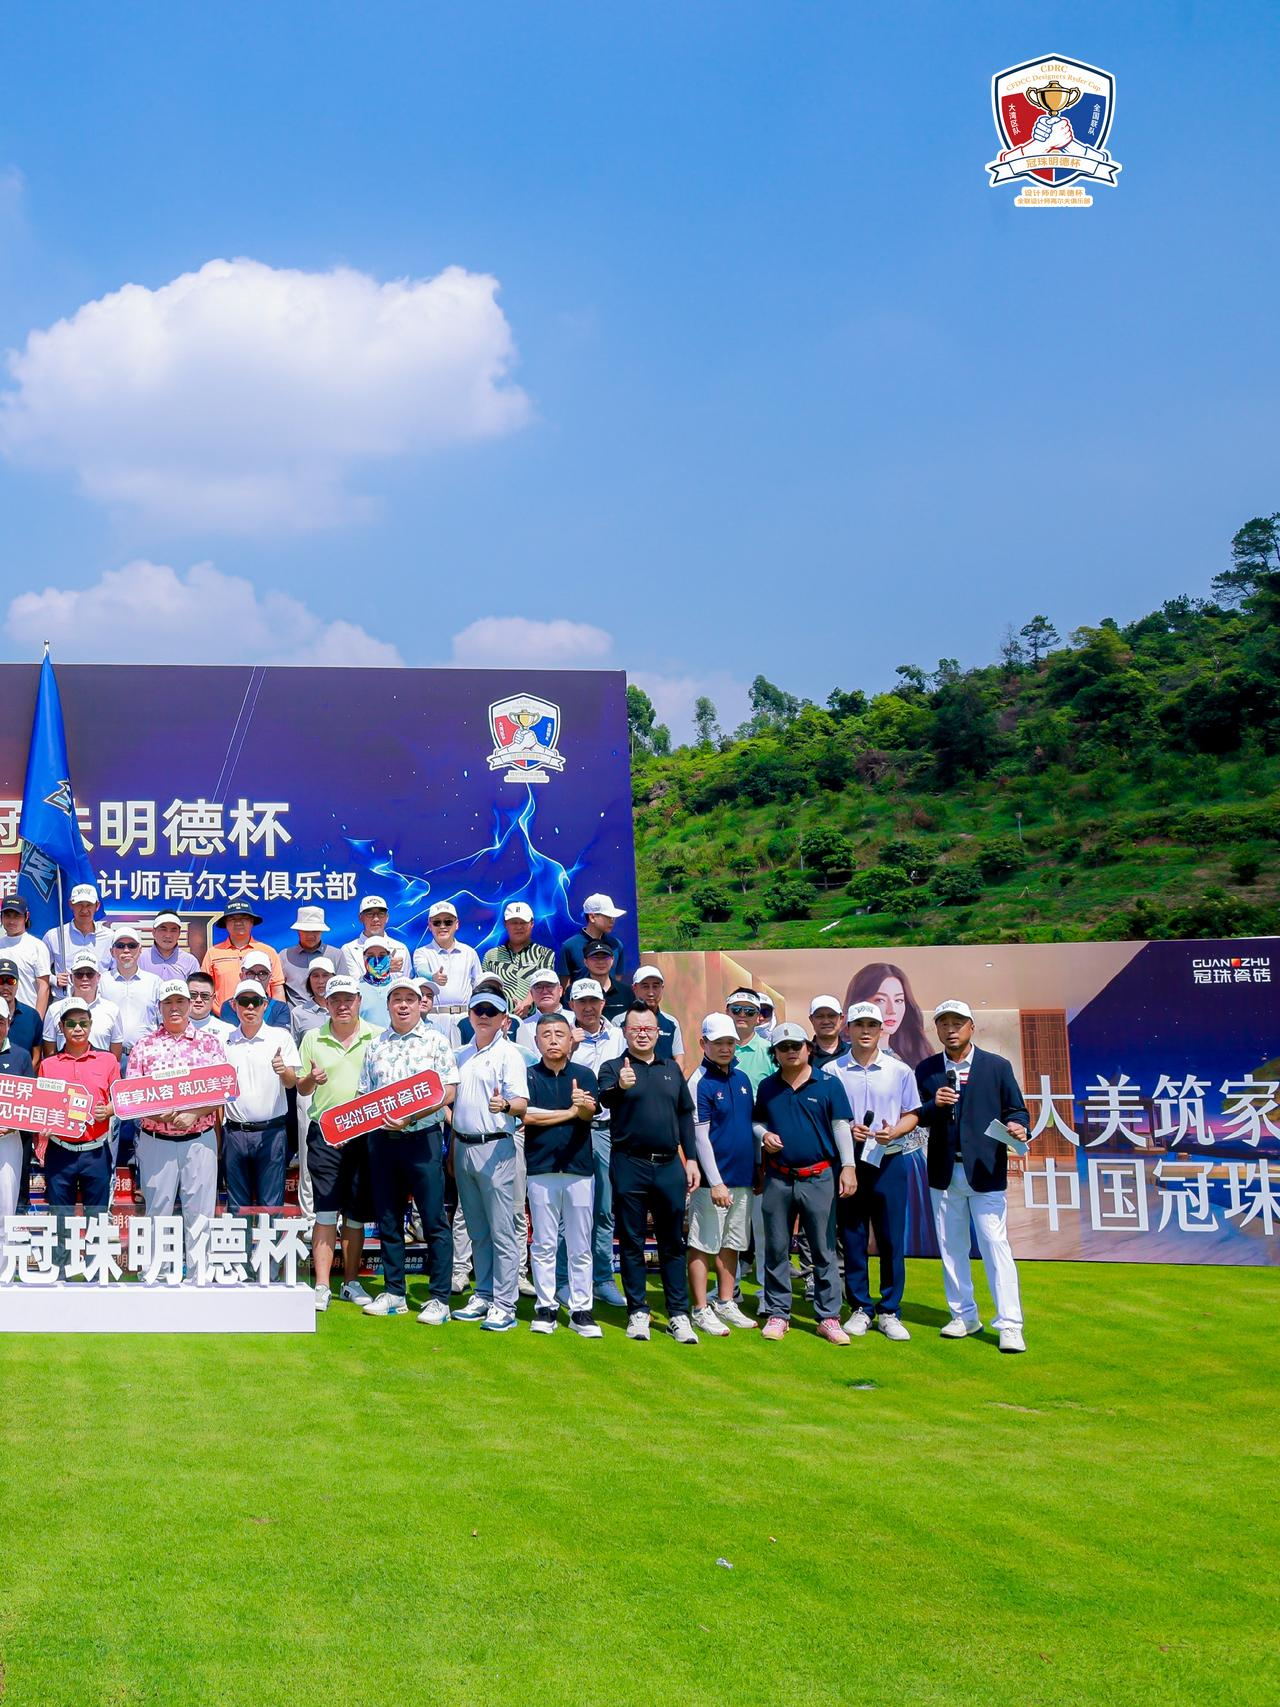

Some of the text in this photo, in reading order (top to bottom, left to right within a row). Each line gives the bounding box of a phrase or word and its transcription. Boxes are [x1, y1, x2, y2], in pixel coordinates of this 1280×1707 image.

[1192, 957, 1270, 968] GUAN ZHU
[1193, 967, 1271, 984] 冠珠瓷砖
[177, 1075, 236, 1097] 筑见美学
[362, 1081, 433, 1121] 冠珠瓷砖
[334, 1107, 363, 1125] GUAN
[1023, 1074, 1280, 1149] 大美筑家
[344, 1114, 366, 1130] ZHU
[1023, 1157, 1280, 1236] 中国冠珠
